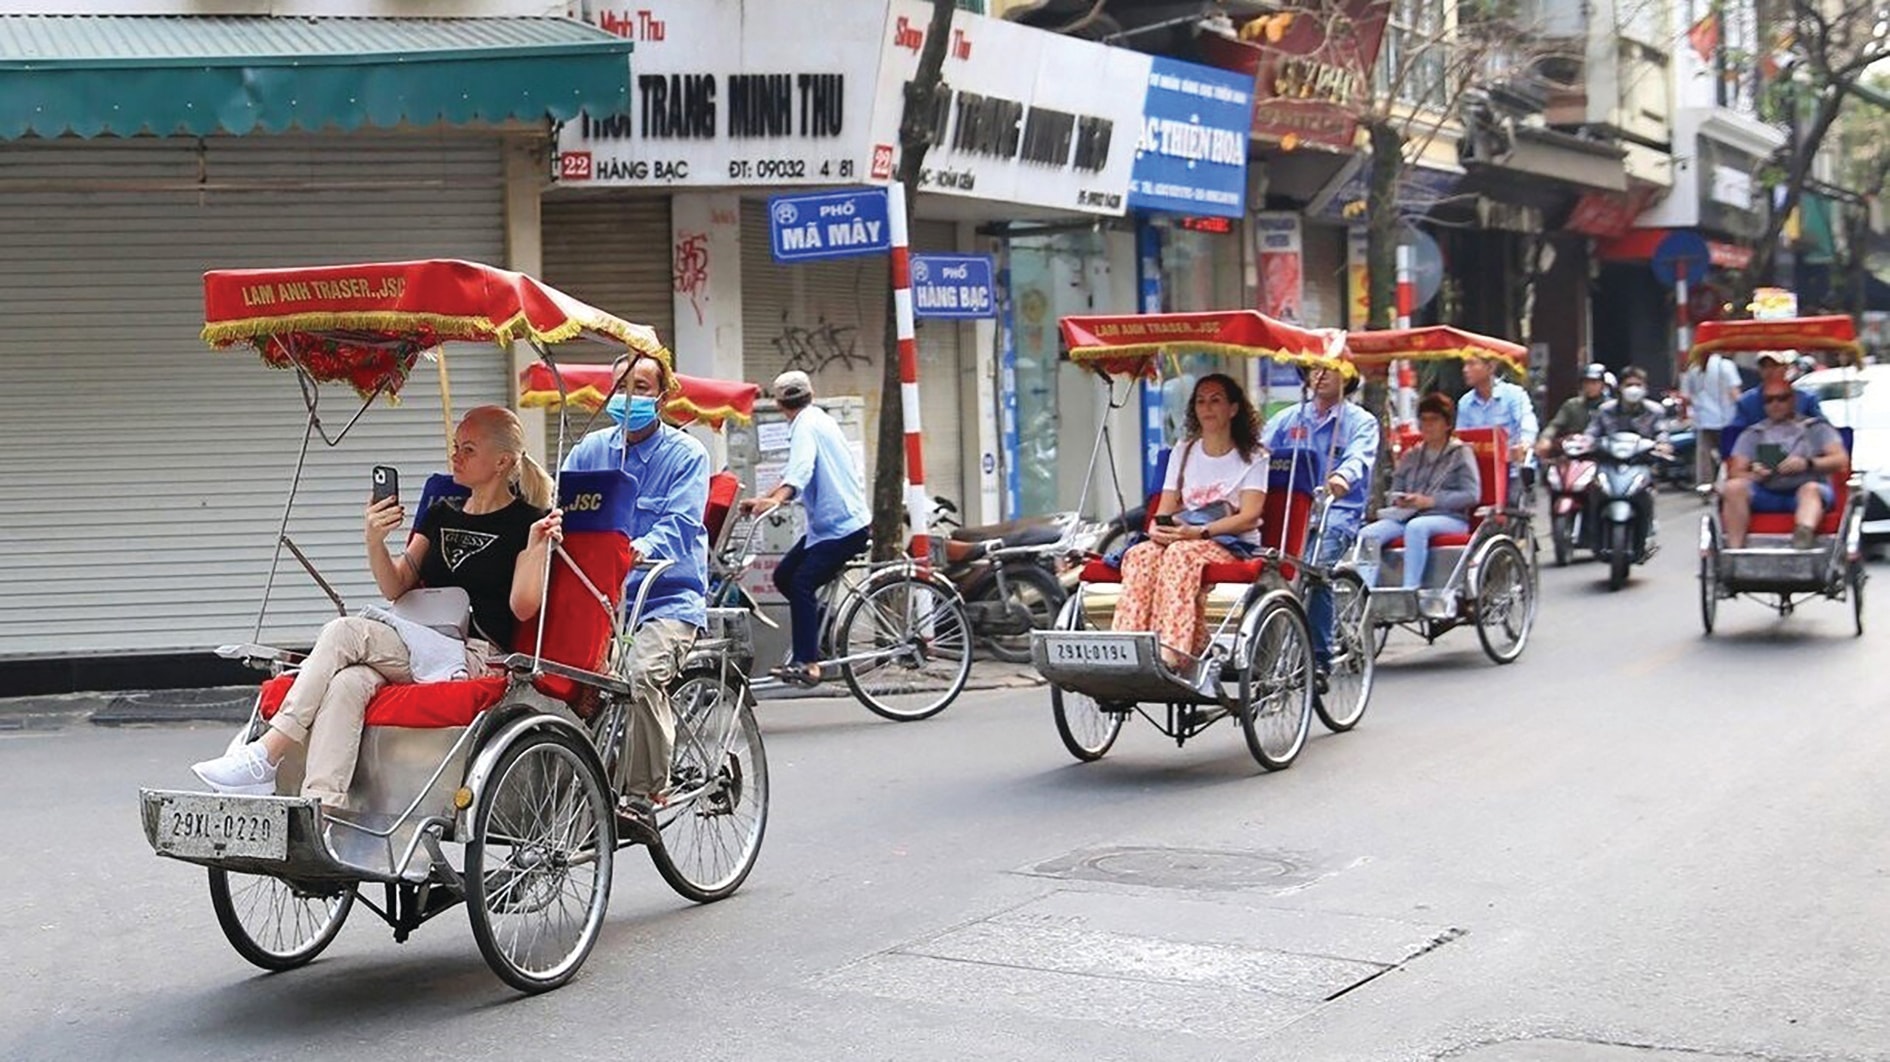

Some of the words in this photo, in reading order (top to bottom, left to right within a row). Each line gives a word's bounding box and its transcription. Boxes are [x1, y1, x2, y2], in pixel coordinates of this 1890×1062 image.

[638, 11, 665, 41] Thu
[638, 74, 717, 137] TRANG
[728, 74, 792, 137] MINH
[798, 74, 844, 137] THU
[564, 157, 589, 176] 22
[597, 157, 649, 179] HÀNG
[654, 160, 688, 183] BẠC
[729, 160, 752, 178] ĐT:
[757, 160, 805, 178] 09032
[820, 199, 855, 217] PHỐ
[782, 222, 822, 250] MÃ
[828, 217, 881, 246] MÂY
[942, 263, 967, 279] PHỐ
[242, 284, 276, 306] LAM
[278, 281, 312, 303] ANH
[917, 282, 957, 308] HÀNG
[960, 287, 988, 312] BẠC
[445, 533, 484, 546] GUESS
[1057, 644, 1128, 661] 29XL-0194
[173, 811, 271, 842] 29XL-0220
